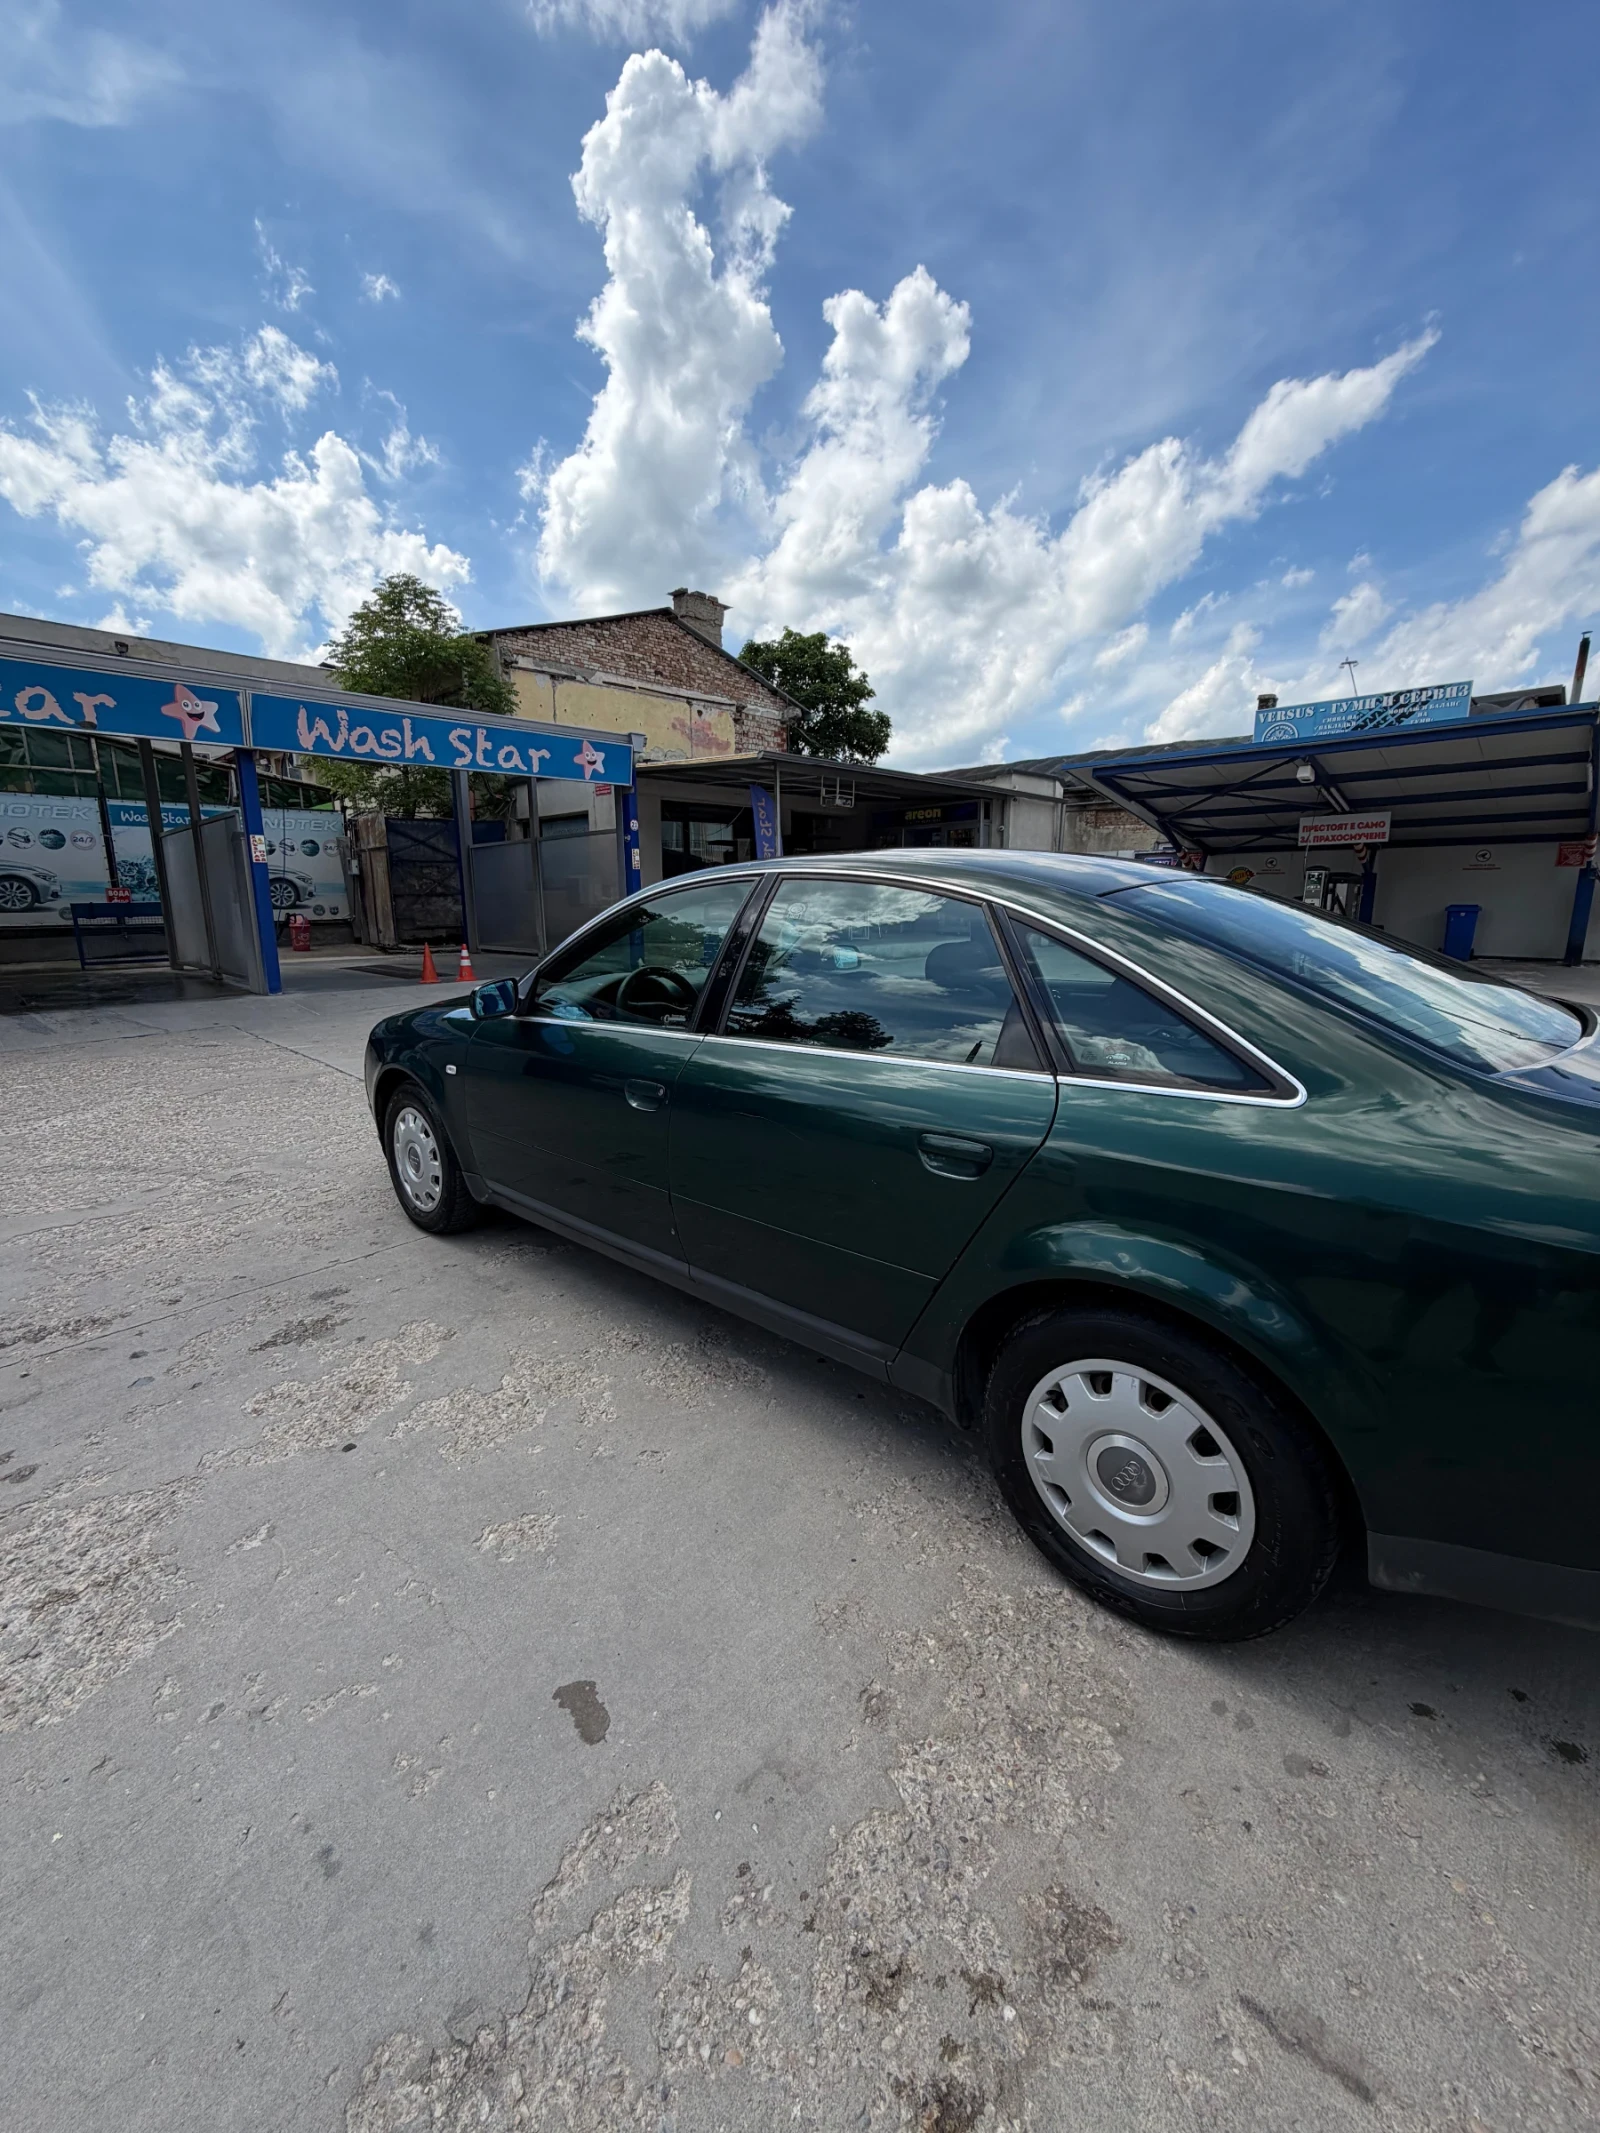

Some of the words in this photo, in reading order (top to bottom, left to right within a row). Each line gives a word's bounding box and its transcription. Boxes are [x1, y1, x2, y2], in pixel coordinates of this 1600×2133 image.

[0, 685, 117, 728] ar
[1258, 706, 1315, 724] VERSUS
[1330, 697, 1376, 714] ГУМИ
[1400, 684, 1469, 704] СЕРВИЗ
[297, 705, 435, 761] Wash
[449, 727, 551, 773] Star
[0, 803, 90, 820] OTEK
[120, 810, 149, 822] Was
[161, 812, 191, 825] Star
[905, 808, 941, 820] areon
[1302, 822, 1348, 833] ПРЕСТОЯТ
[1357, 820, 1386, 829] САМО
[1313, 832, 1387, 843] ПРАХОСМУЧЕНЕ
